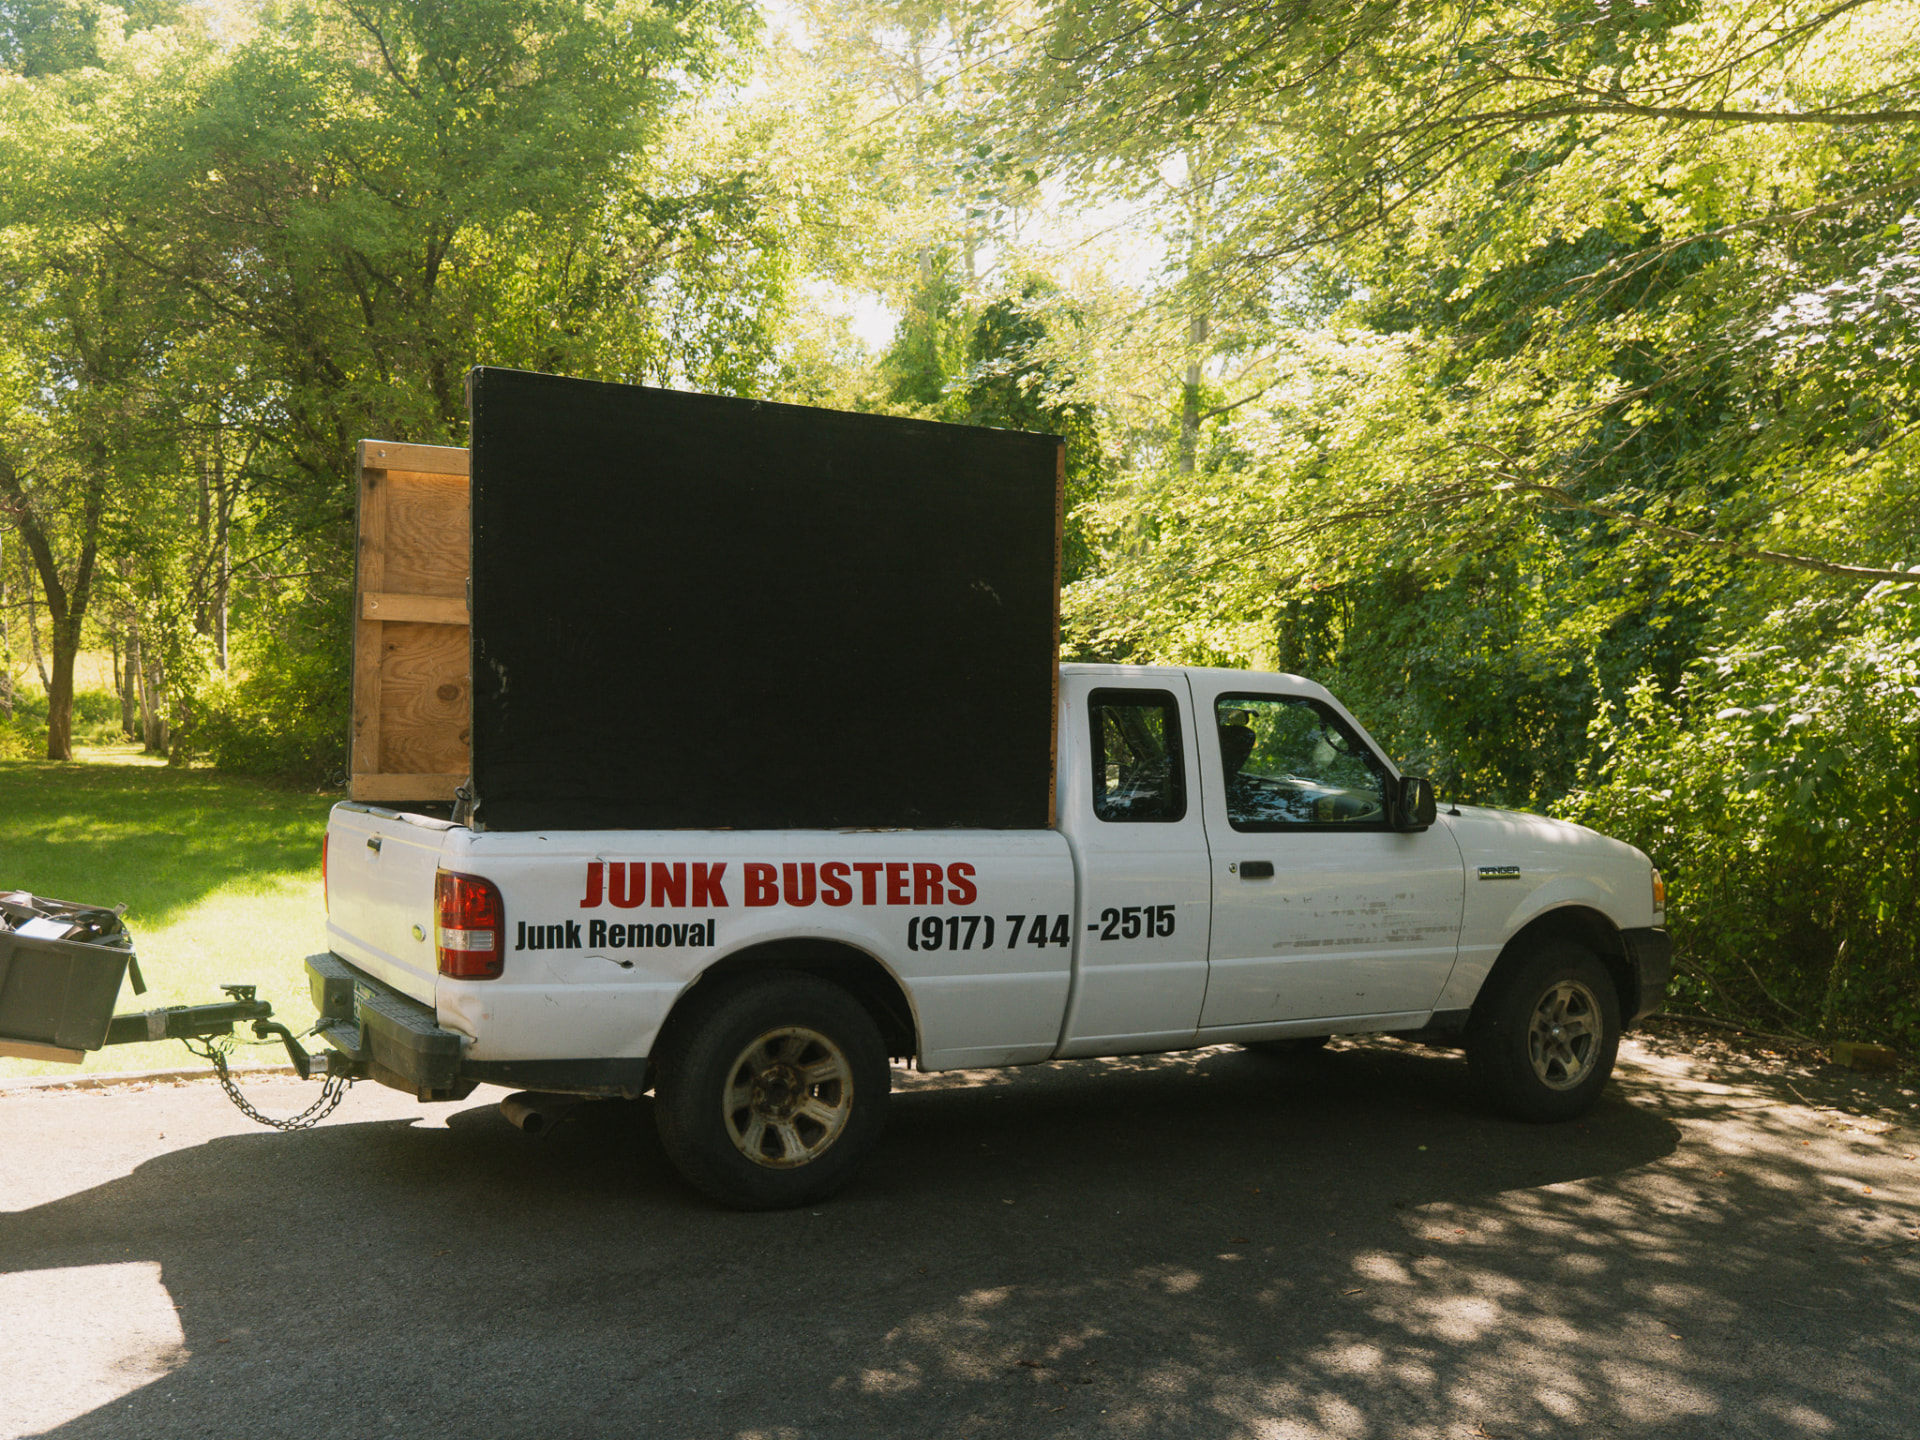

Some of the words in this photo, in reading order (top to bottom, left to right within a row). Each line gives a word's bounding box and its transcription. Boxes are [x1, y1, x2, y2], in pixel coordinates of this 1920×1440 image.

[580, 862, 728, 908] JUNK
[743, 862, 977, 907] BUSTERS
[1479, 865, 1520, 876] RANGER
[515, 920, 582, 951] Junk
[589, 918, 715, 948] Removal
[908, 915, 995, 951] (917)
[1006, 914, 1070, 949] 744
[1087, 904, 1176, 942] -2515
